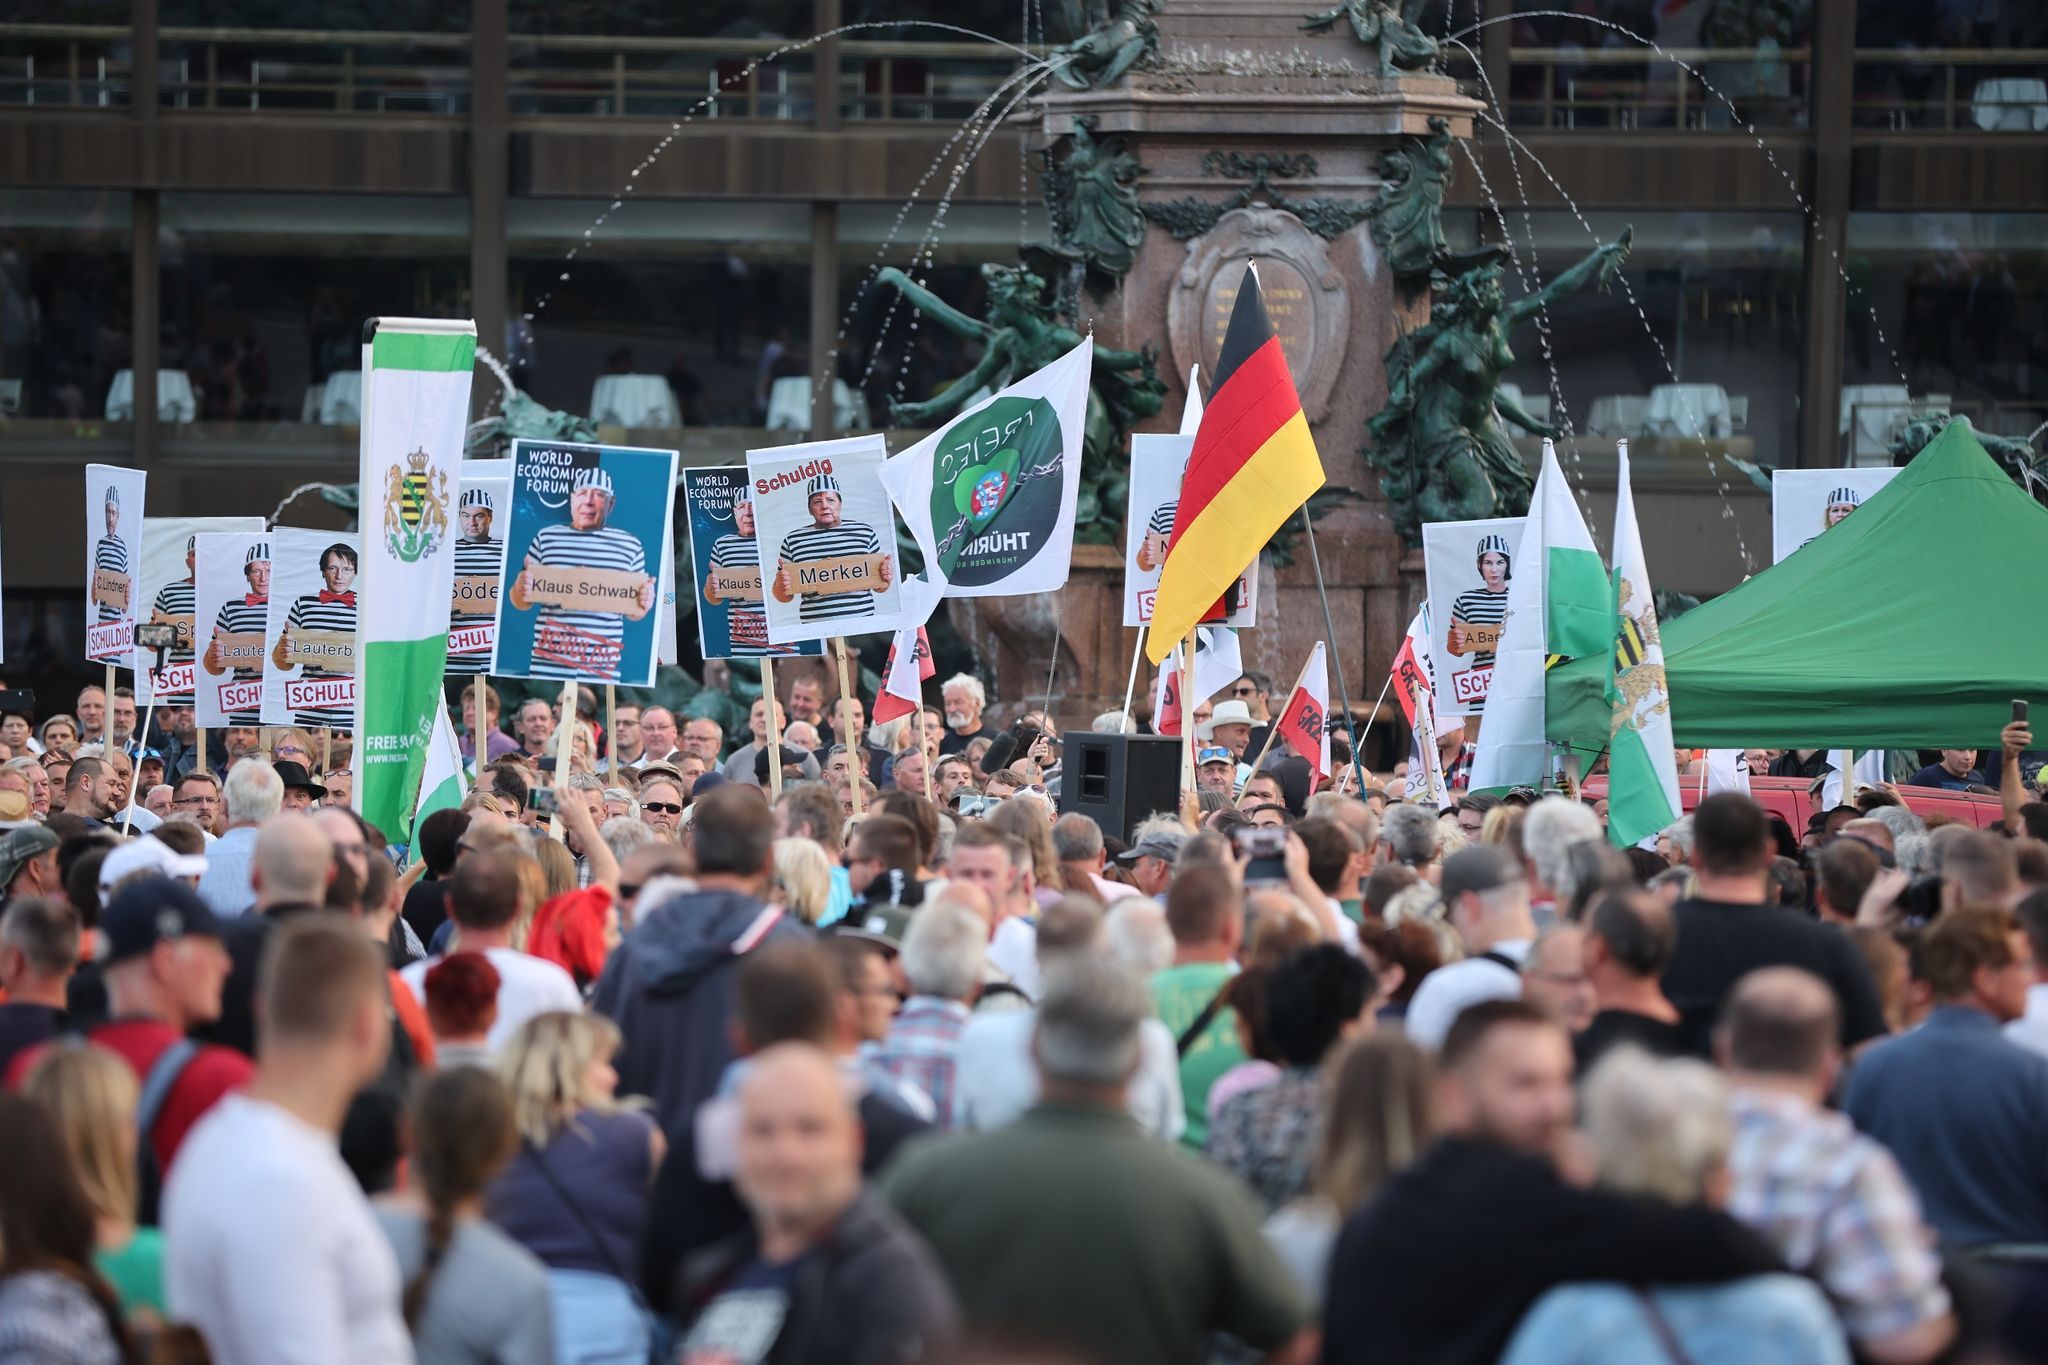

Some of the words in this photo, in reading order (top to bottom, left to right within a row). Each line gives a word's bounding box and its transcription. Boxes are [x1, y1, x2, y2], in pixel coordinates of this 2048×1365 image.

[529, 450, 573, 466] WORLD
[696, 475, 729, 487] WORLD
[755, 458, 833, 495] Schuldig
[526, 479, 569, 494] FORUM
[698, 499, 732, 510] FORUM
[799, 561, 870, 585] Merkel
[531, 578, 573, 594] Klaus
[578, 581, 638, 600] Schwab
[718, 578, 751, 590] Klaus
[91, 626, 131, 651] SCHULDIG
[447, 628, 495, 649] CHUL
[293, 640, 356, 657] Lauterb
[225, 685, 263, 706] SCH
